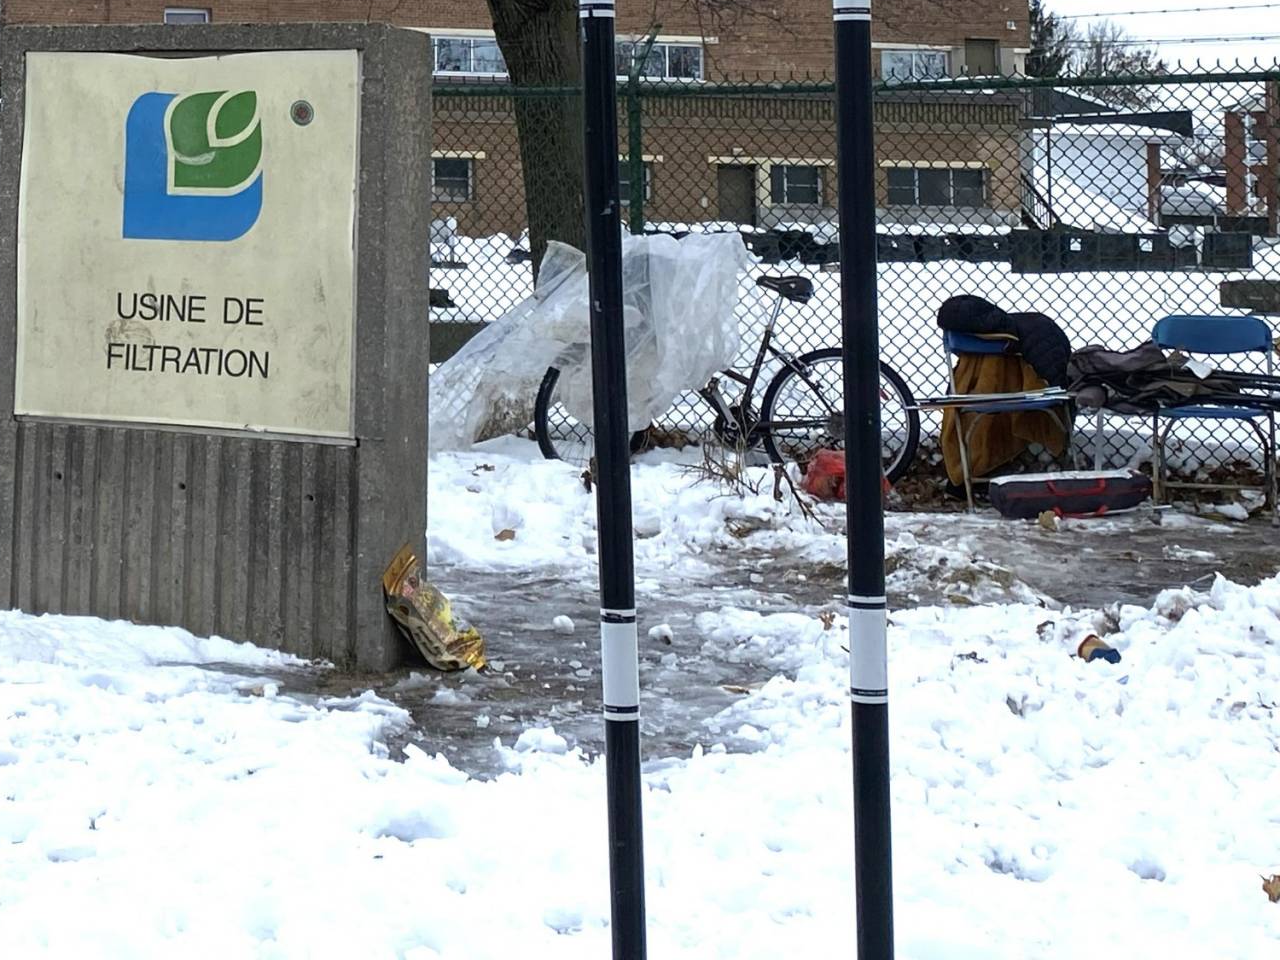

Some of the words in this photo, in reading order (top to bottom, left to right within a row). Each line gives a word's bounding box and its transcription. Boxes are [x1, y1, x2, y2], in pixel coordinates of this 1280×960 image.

[117, 292, 207, 323] USINE
[223, 297, 265, 326] DE
[107, 342, 269, 379] FILTRATION
